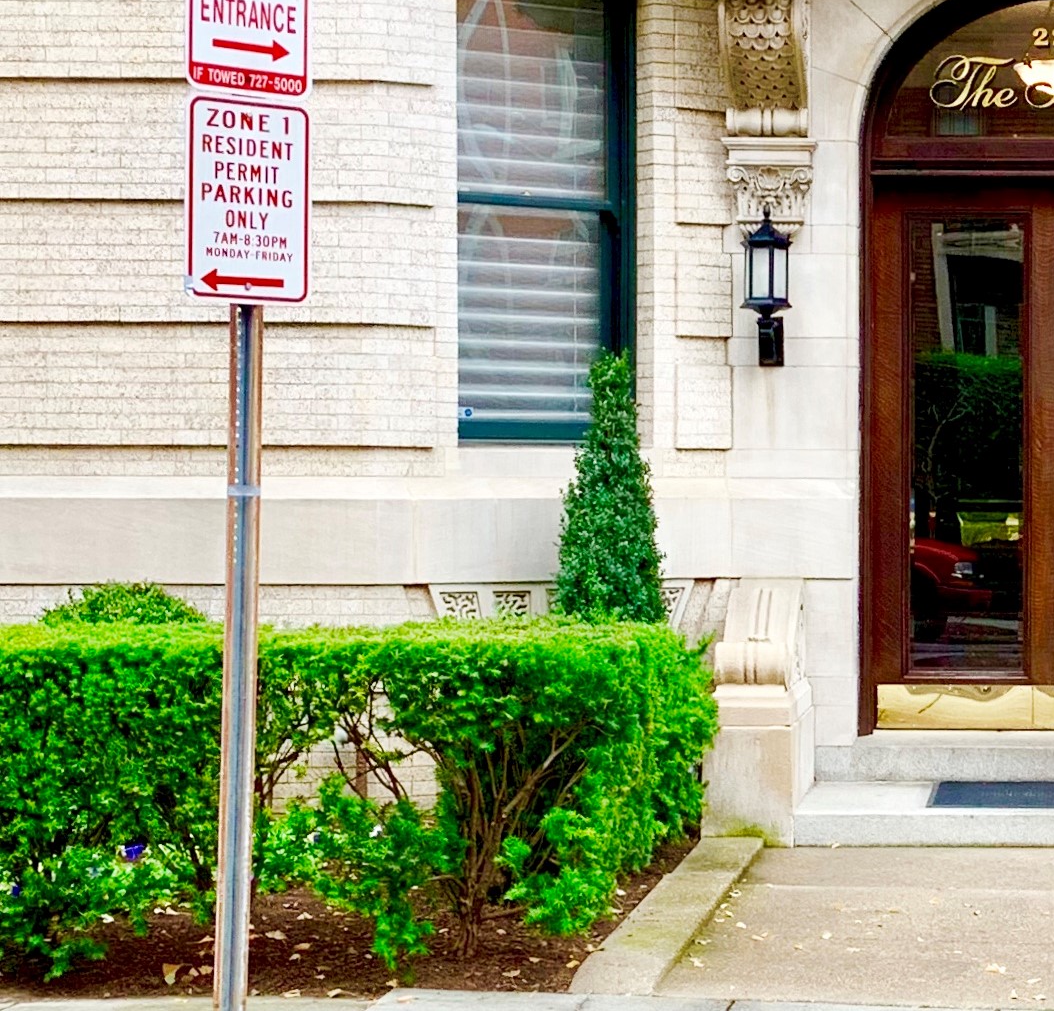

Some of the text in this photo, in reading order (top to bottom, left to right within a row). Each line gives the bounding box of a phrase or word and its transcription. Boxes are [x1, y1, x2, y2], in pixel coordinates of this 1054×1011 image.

[193, 66, 303, 93] IF TOWED 727-5000
[930, 54, 1018, 111] The
[206, 108, 290, 135] ZONE 1
[202, 134, 294, 161] RESIDENT
[214, 161, 280, 185] PERMIT
[201, 182, 293, 209] PARKING
[225, 209, 269, 231] ONLY
